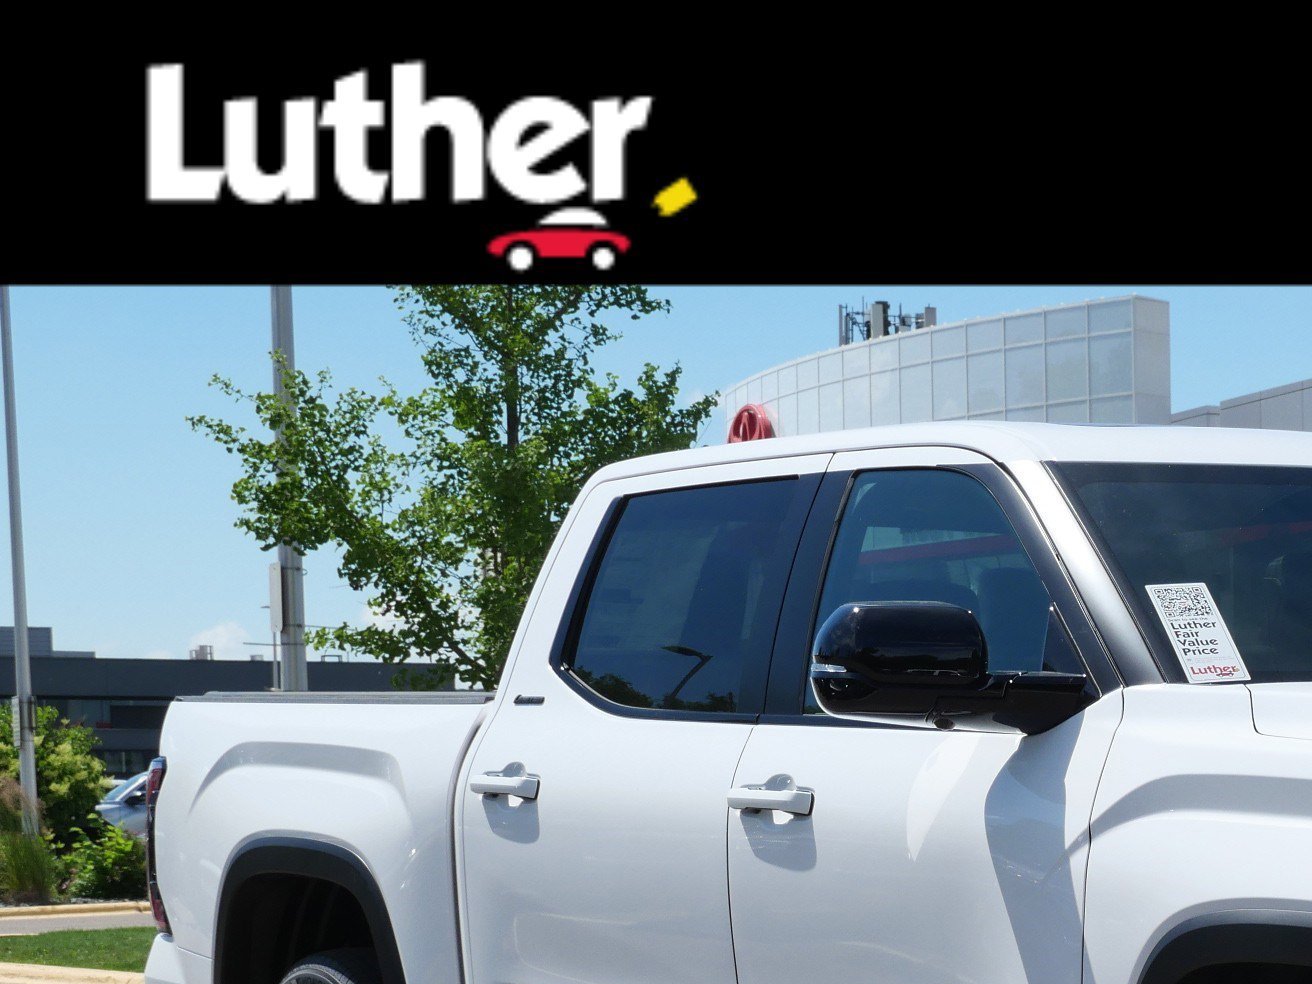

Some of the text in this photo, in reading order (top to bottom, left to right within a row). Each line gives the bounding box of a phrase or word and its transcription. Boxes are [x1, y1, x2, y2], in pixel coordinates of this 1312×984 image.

[1170, 620, 1217, 630] Luther
[1174, 629, 1200, 639] Fair
[1177, 638, 1219, 647] Value
[1182, 646, 1219, 656] Price
[1190, 664, 1237, 675] Luther
